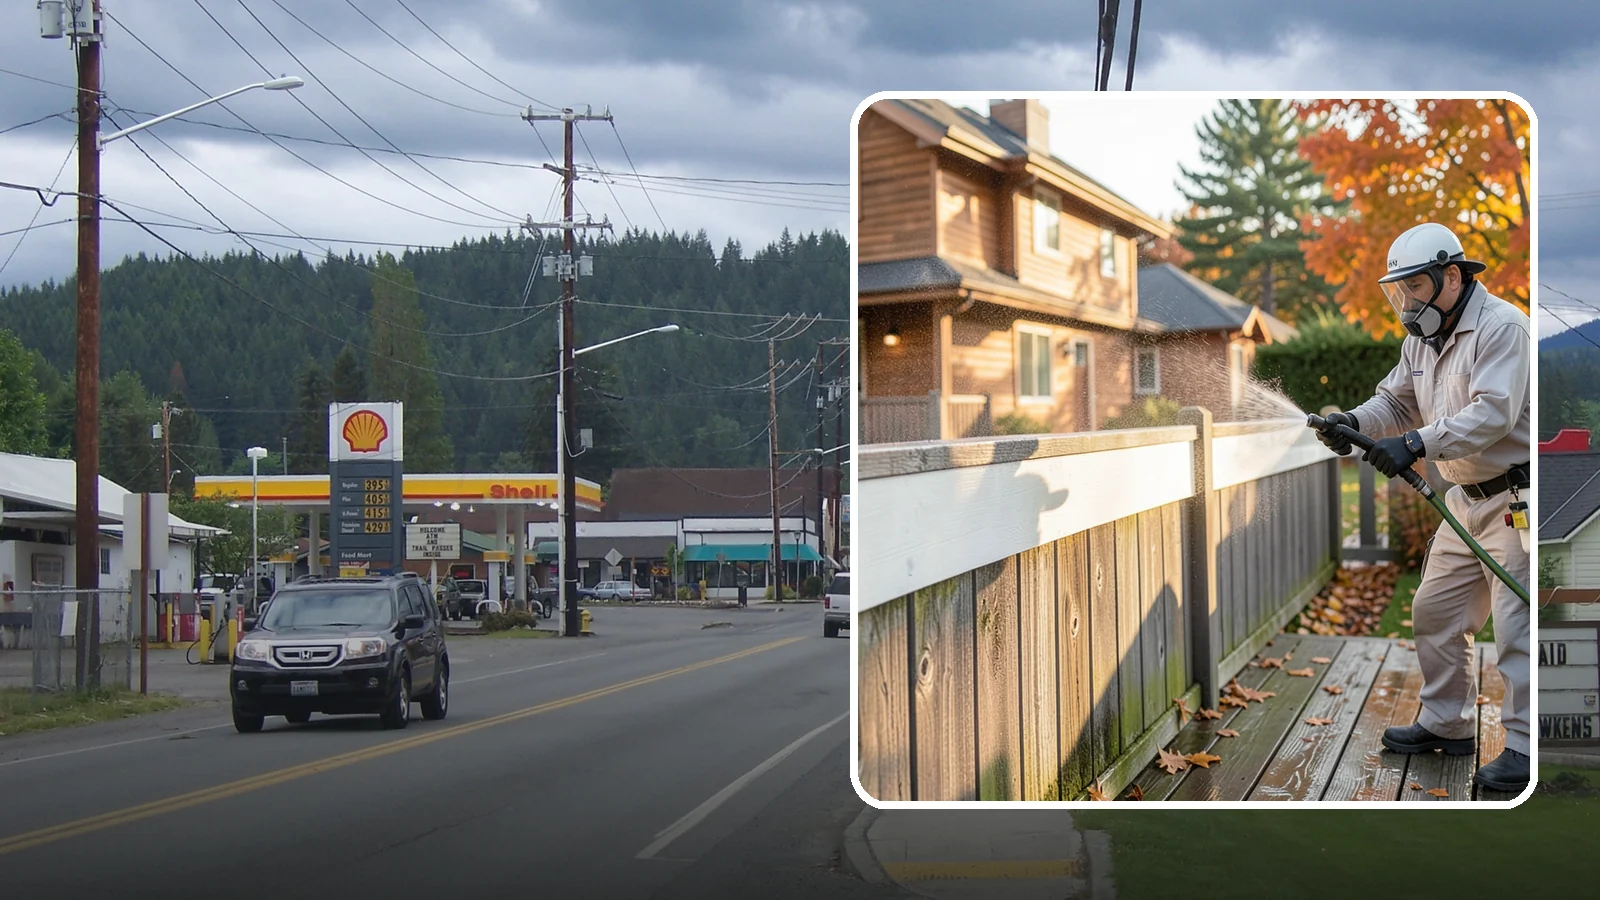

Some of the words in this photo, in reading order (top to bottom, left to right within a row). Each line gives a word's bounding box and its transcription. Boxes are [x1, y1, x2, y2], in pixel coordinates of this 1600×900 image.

[366, 480, 383, 490] 395
[490, 484, 547, 499] Shell
[366, 494, 383, 504] 405
[366, 508, 383, 518] 415
[366, 522, 383, 533] 429
